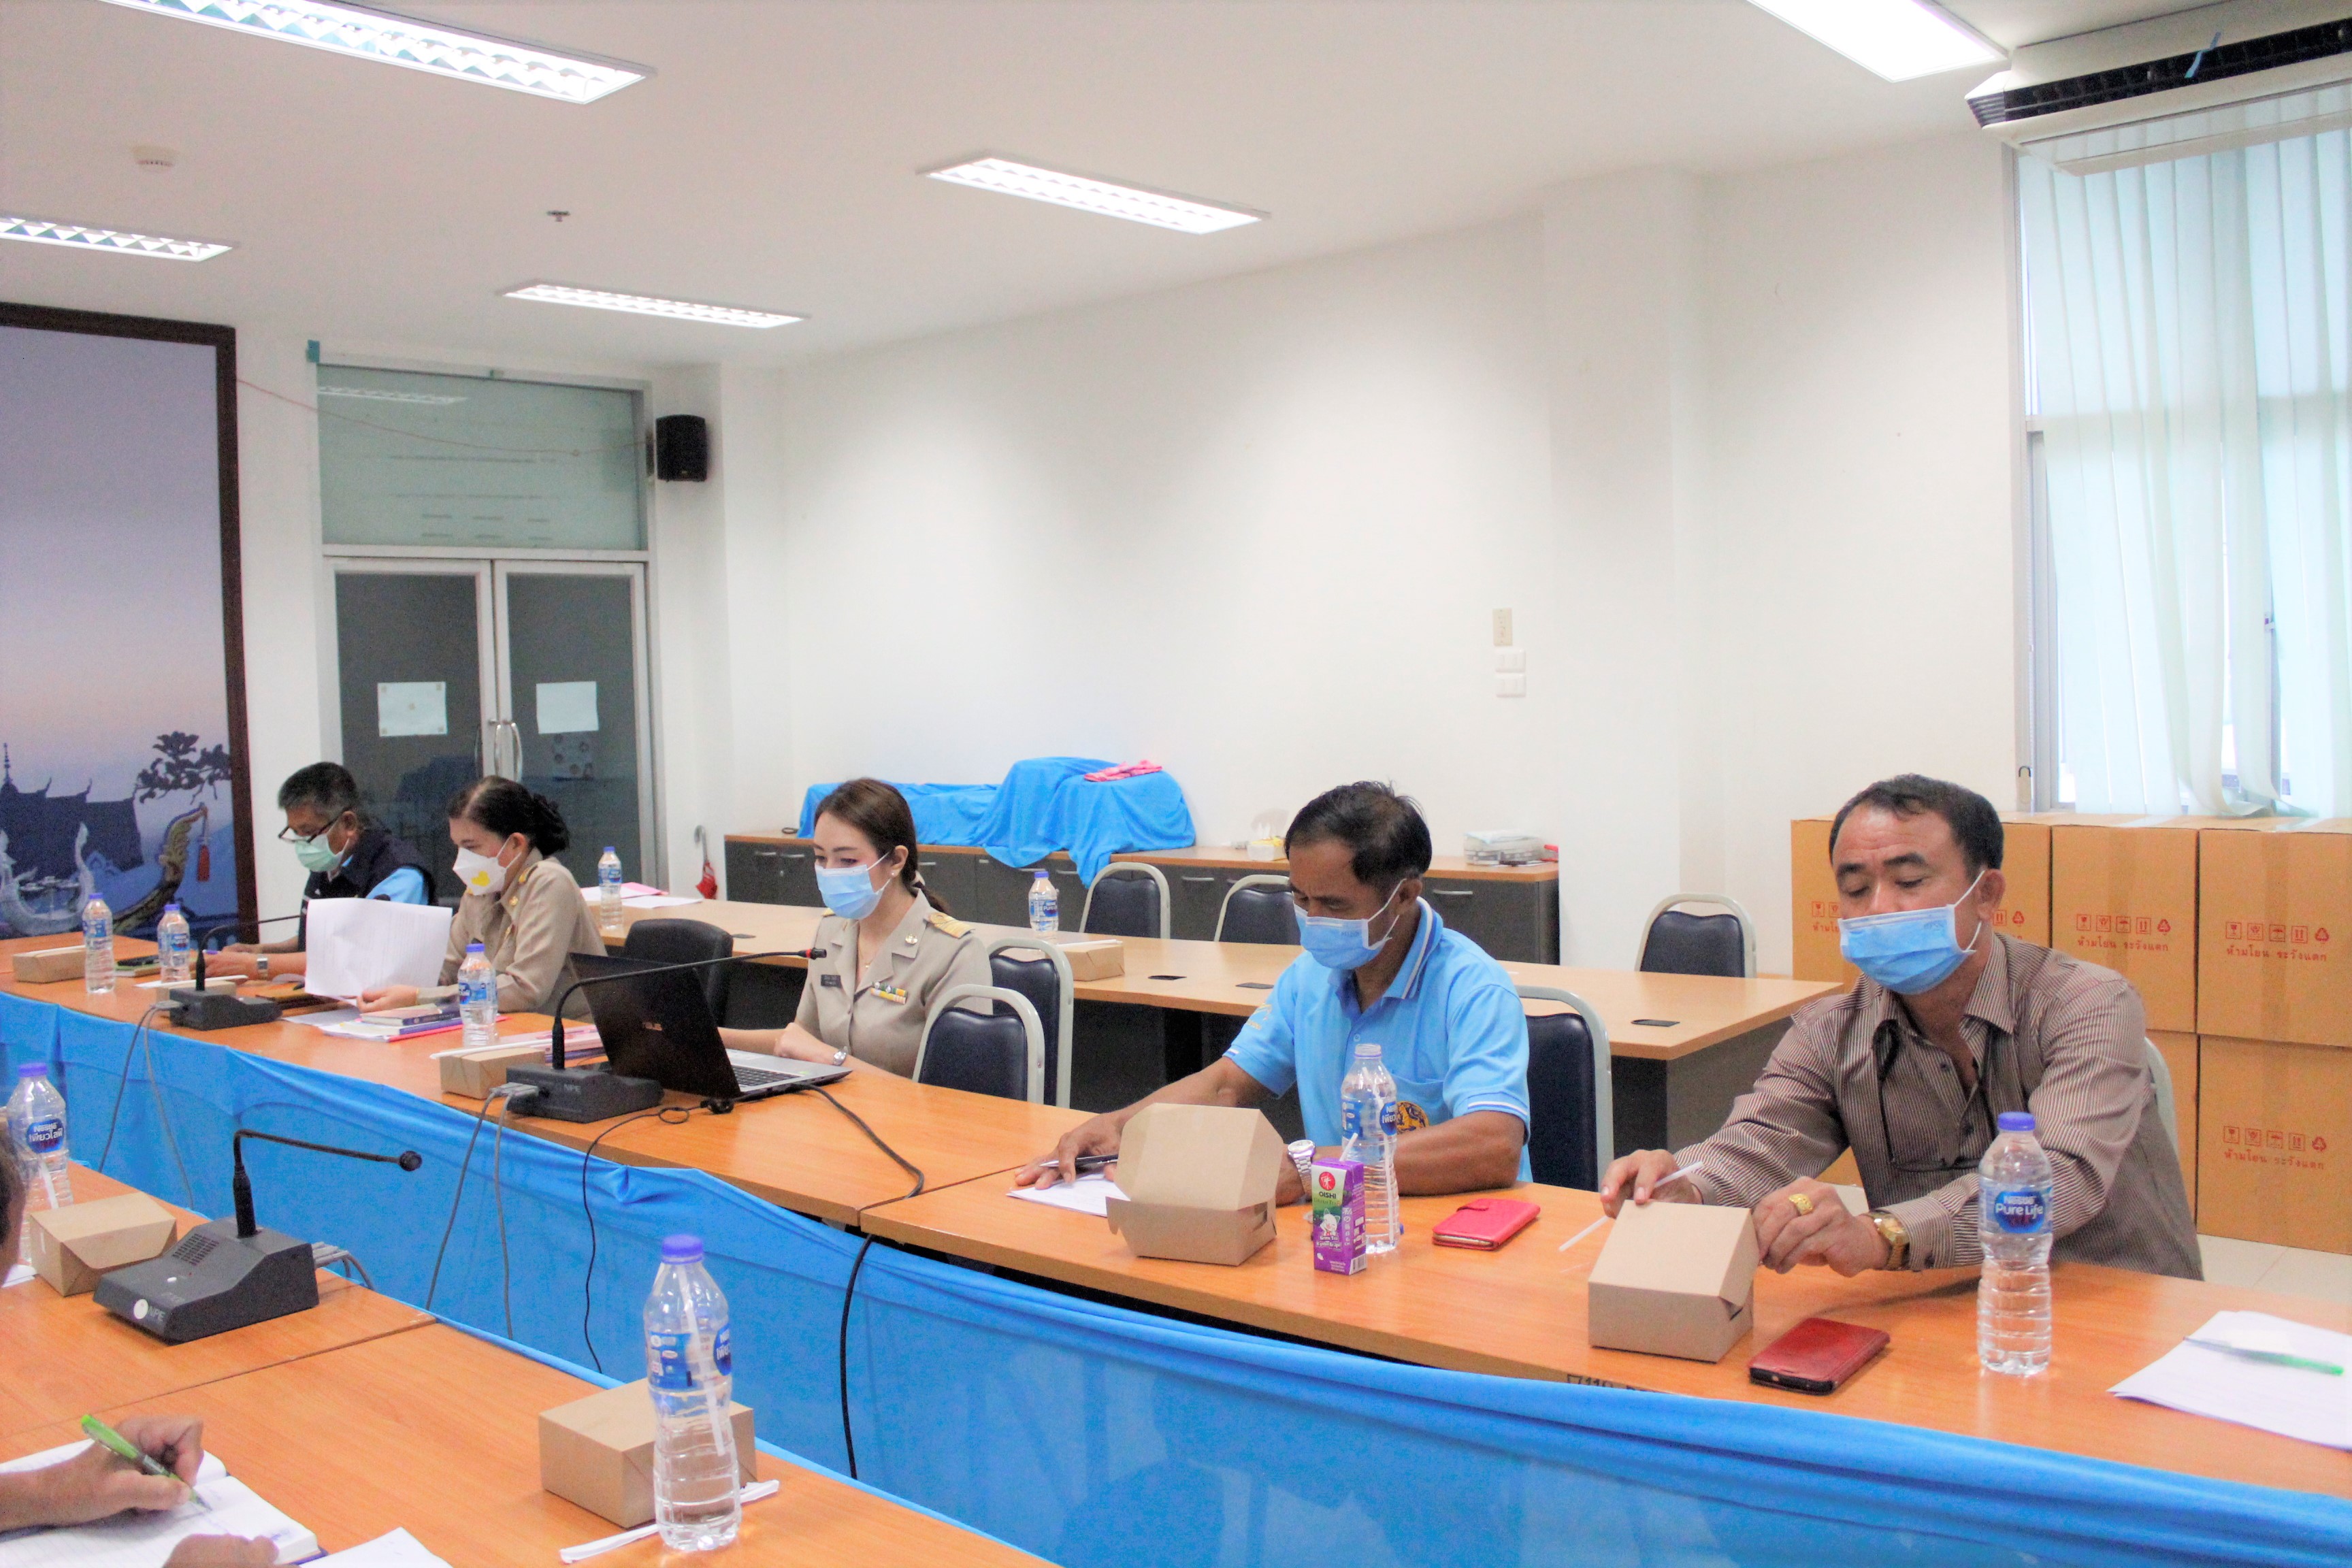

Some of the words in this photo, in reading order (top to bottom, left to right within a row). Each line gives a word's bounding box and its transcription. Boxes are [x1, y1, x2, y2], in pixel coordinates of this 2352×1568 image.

[1813, 921, 1840, 932] ห้ามโย
[2078, 935, 2117, 949] ห้ามโยน
[2124, 940, 2168, 951] ระวังแตก
[2227, 944, 2270, 958] ห้ามโยน
[2277, 949, 2327, 961] ระวังแตก
[2224, 1148, 2268, 1163] ห้ามโยน
[1319, 1191, 1337, 1199] OISHI
[1995, 1203, 2024, 1215] Pure
[2025, 1203, 2044, 1220] Life
